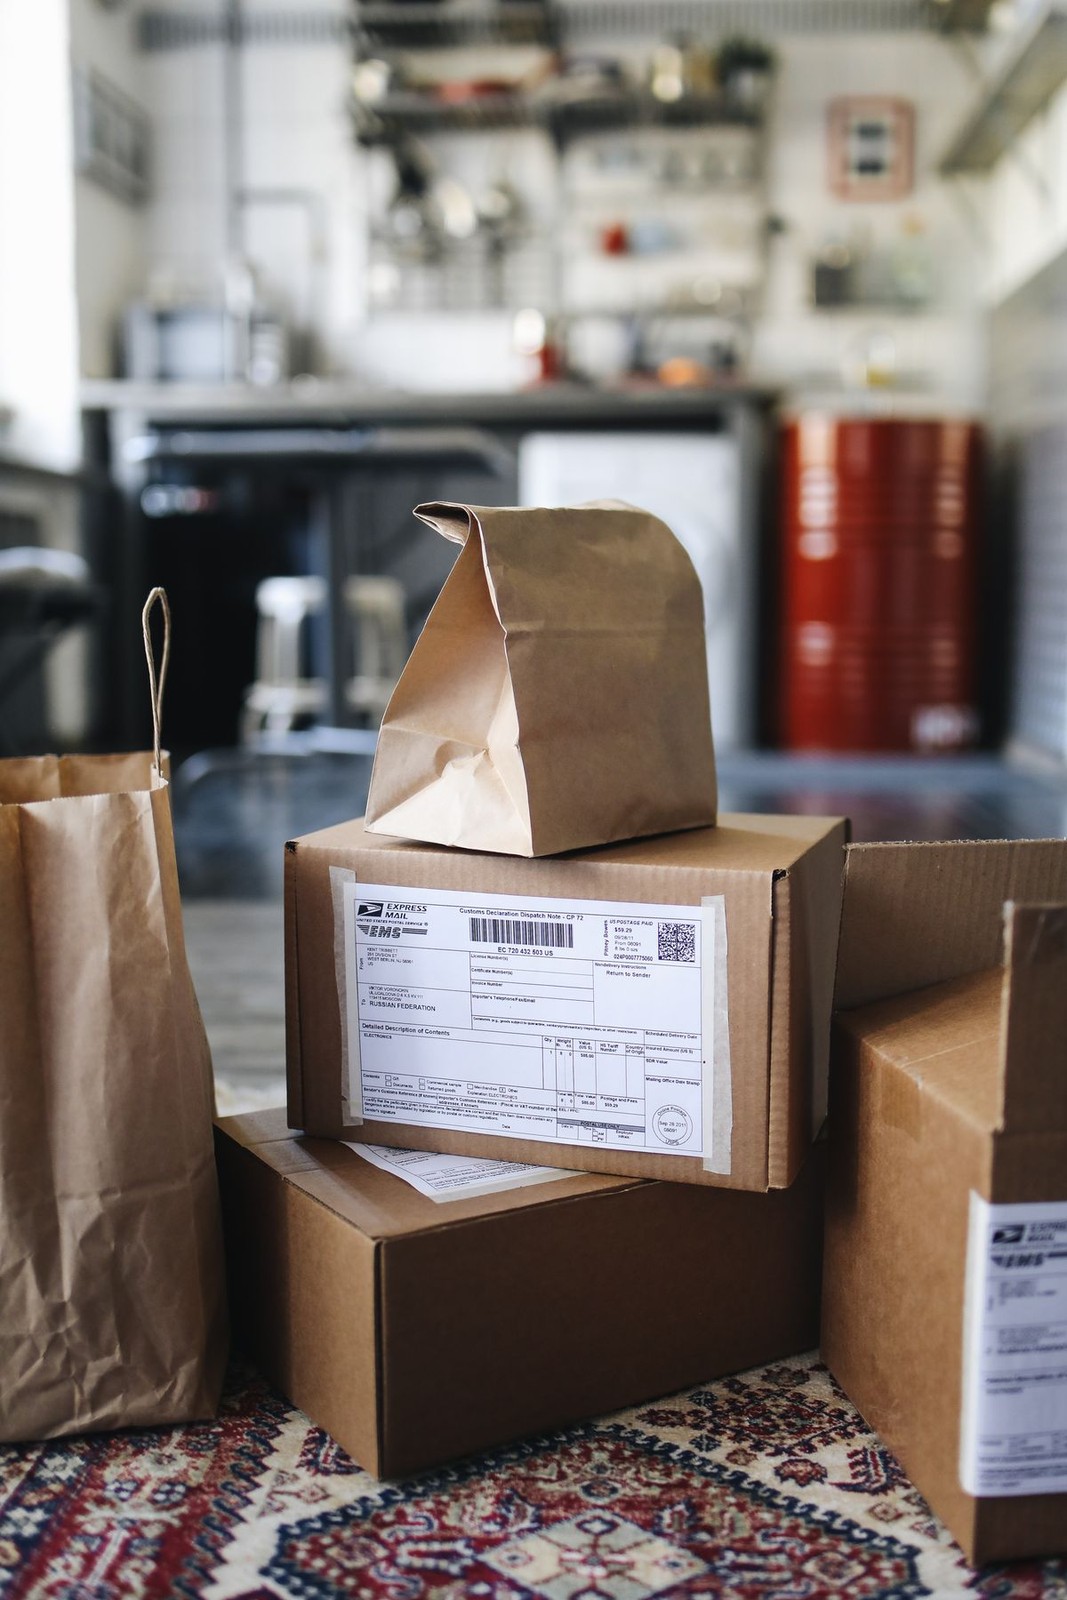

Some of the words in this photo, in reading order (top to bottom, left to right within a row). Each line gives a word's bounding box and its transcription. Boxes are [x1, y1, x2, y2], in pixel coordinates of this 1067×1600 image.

[387, 903, 428, 912] EXPRESS
[369, 925, 401, 938] EMS
[397, 1003, 436, 1011] FEDERATION
[385, 1025, 416, 1033] Description
